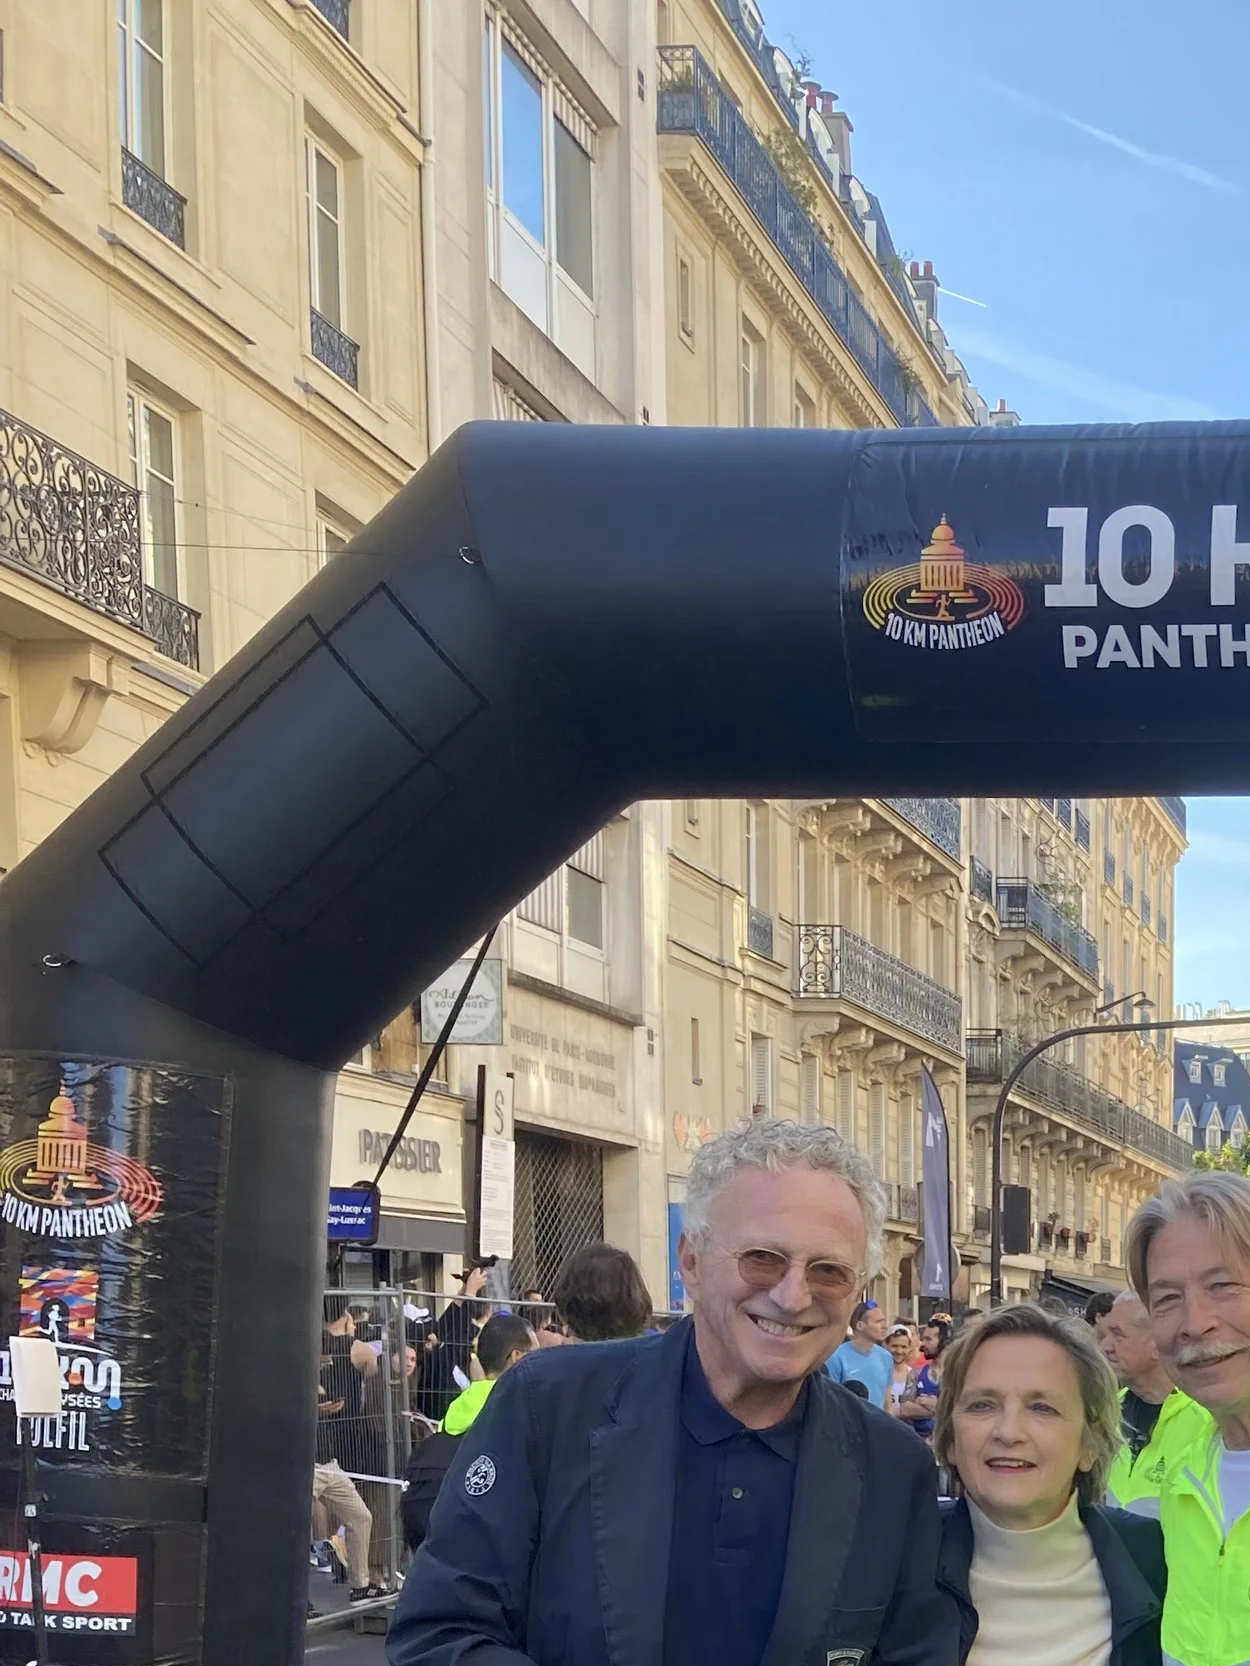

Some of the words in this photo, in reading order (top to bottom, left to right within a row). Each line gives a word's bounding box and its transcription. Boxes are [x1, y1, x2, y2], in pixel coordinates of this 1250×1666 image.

[1044, 504, 1176, 608] 10
[885, 612, 903, 641] 10
[903, 619, 926, 648] KM
[929, 611, 1005, 650] PANTHEON
[434, 1001, 489, 1009] BOUNGER
[1, 1192, 18, 1223] 10
[15, 1201, 39, 1234] KM
[41, 1201, 133, 1238] PANTHEON
[0, 1556, 103, 1607] RMC
[11, 1611, 57, 1628] TAK
[62, 1615, 132, 1631] SPORT
